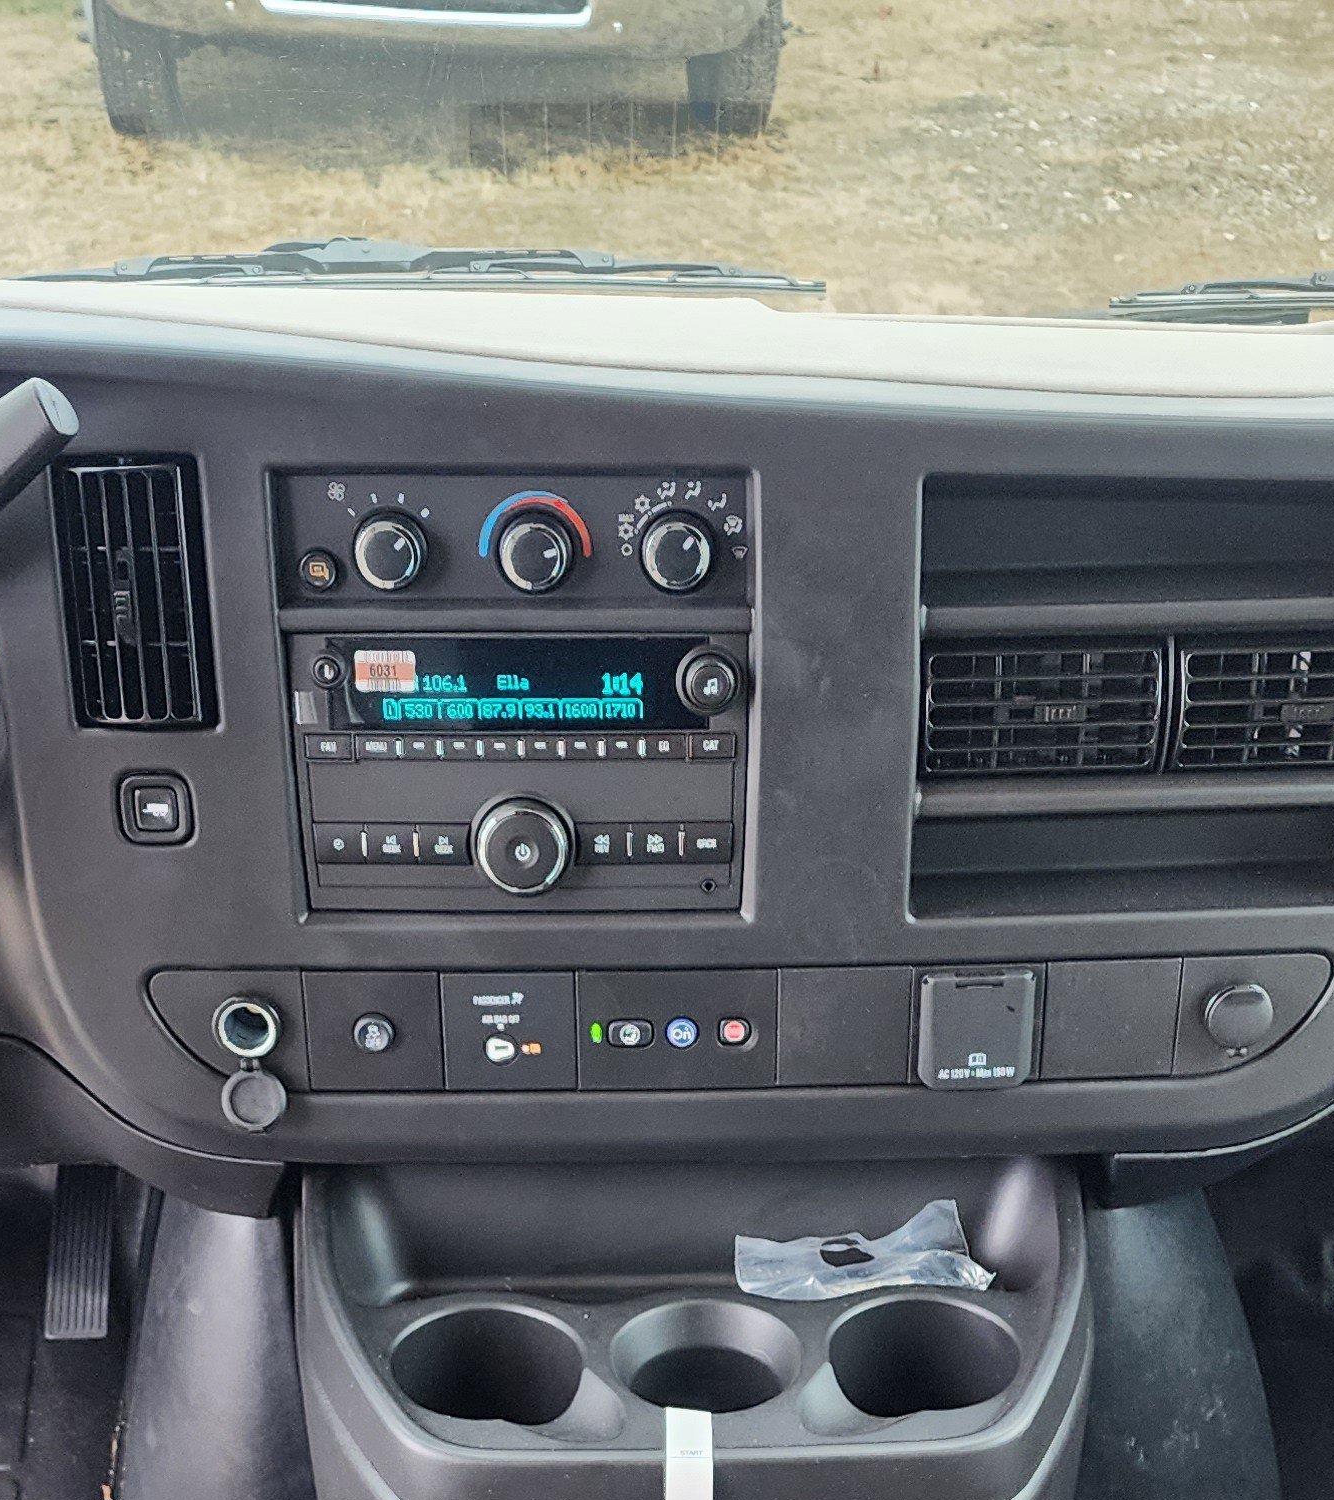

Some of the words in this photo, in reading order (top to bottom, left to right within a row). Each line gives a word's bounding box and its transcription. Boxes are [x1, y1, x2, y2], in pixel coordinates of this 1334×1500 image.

[369, 664, 398, 678] 6031
[422, 674, 467, 692] 106.1
[496, 674, 530, 691] Ella
[601, 672, 644, 696] 1:14
[446, 703, 474, 718] 600
[605, 703, 636, 719] 1710
